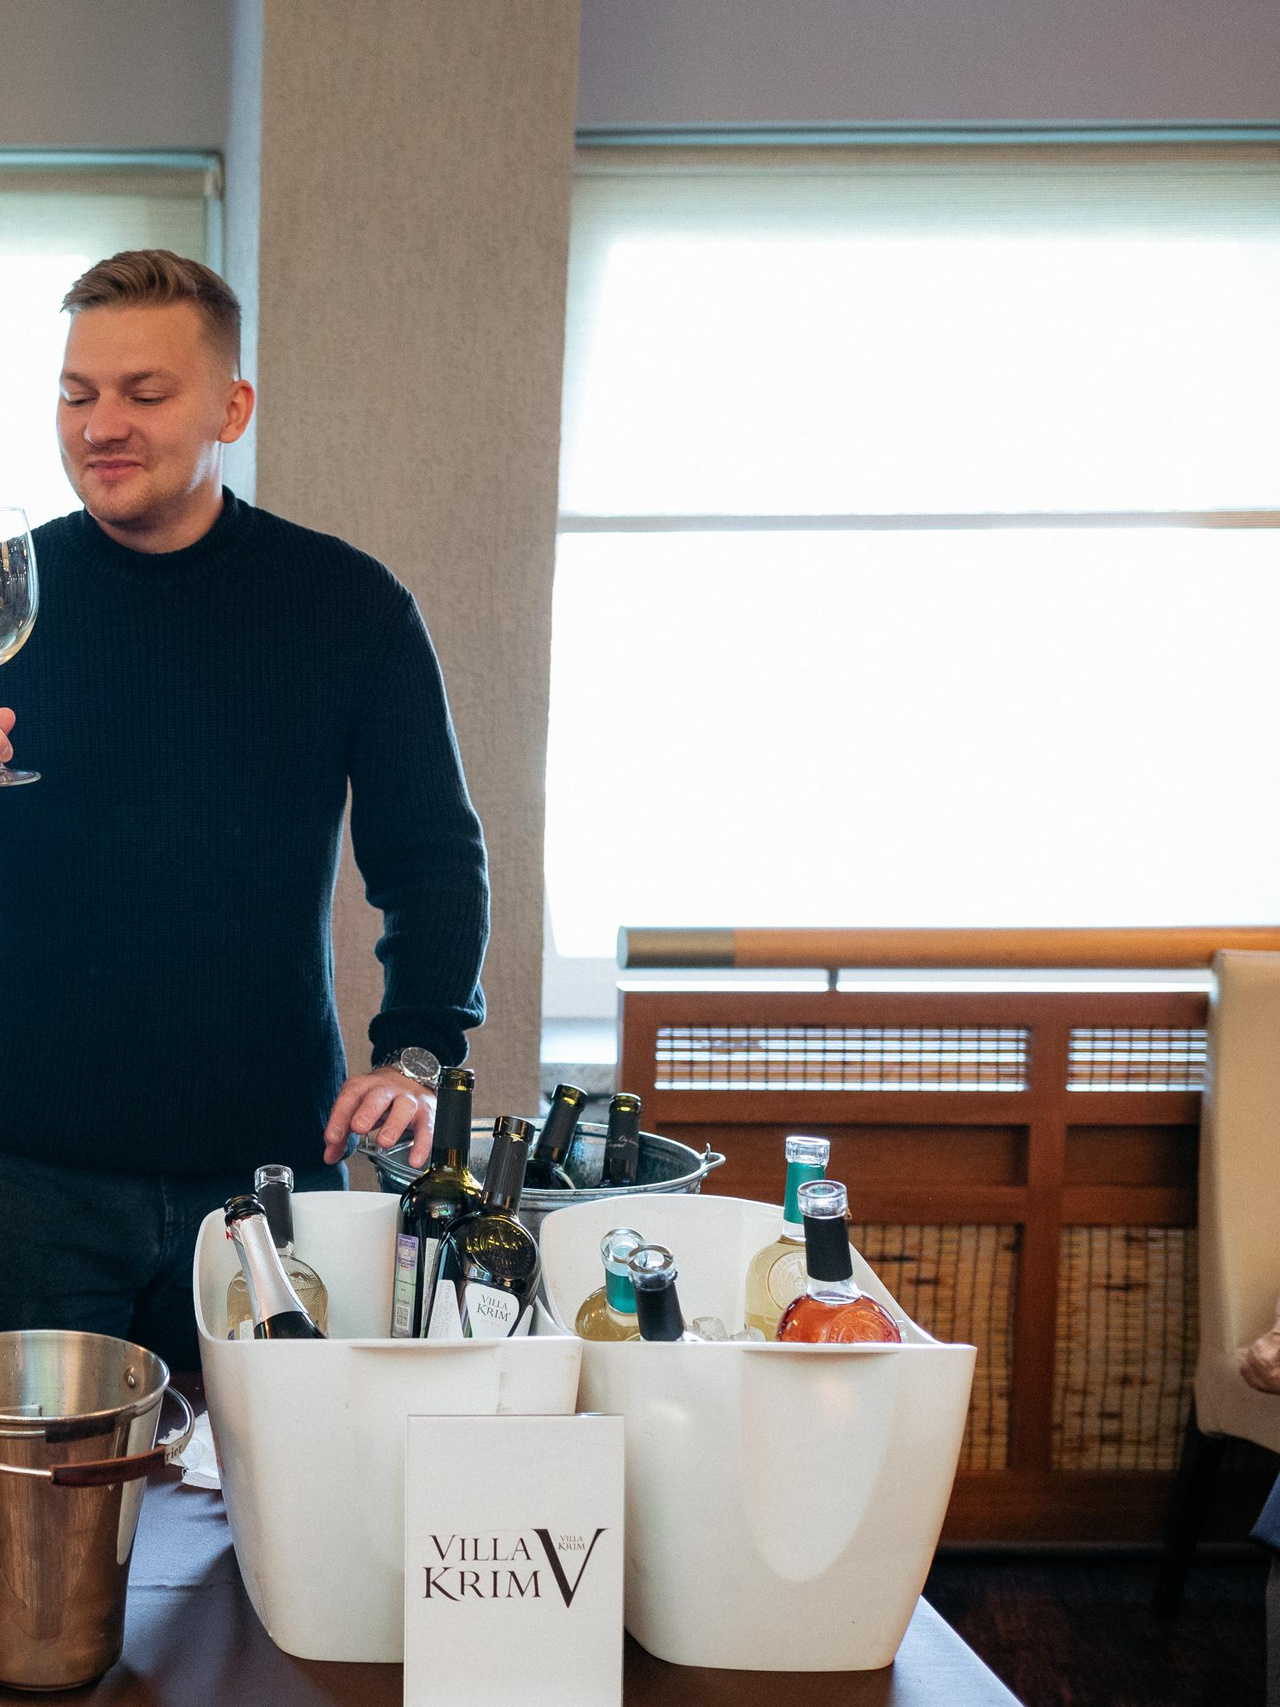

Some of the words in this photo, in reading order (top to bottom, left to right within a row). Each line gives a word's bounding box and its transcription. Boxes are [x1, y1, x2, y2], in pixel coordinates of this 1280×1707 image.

[476, 1302, 509, 1322] KRIM
[481, 1294, 508, 1311] VILLA
[428, 1534, 533, 1561] VILLA
[558, 1542, 587, 1551] KRIM
[531, 1528, 610, 1608] V
[422, 1566, 542, 1601] KRIM
